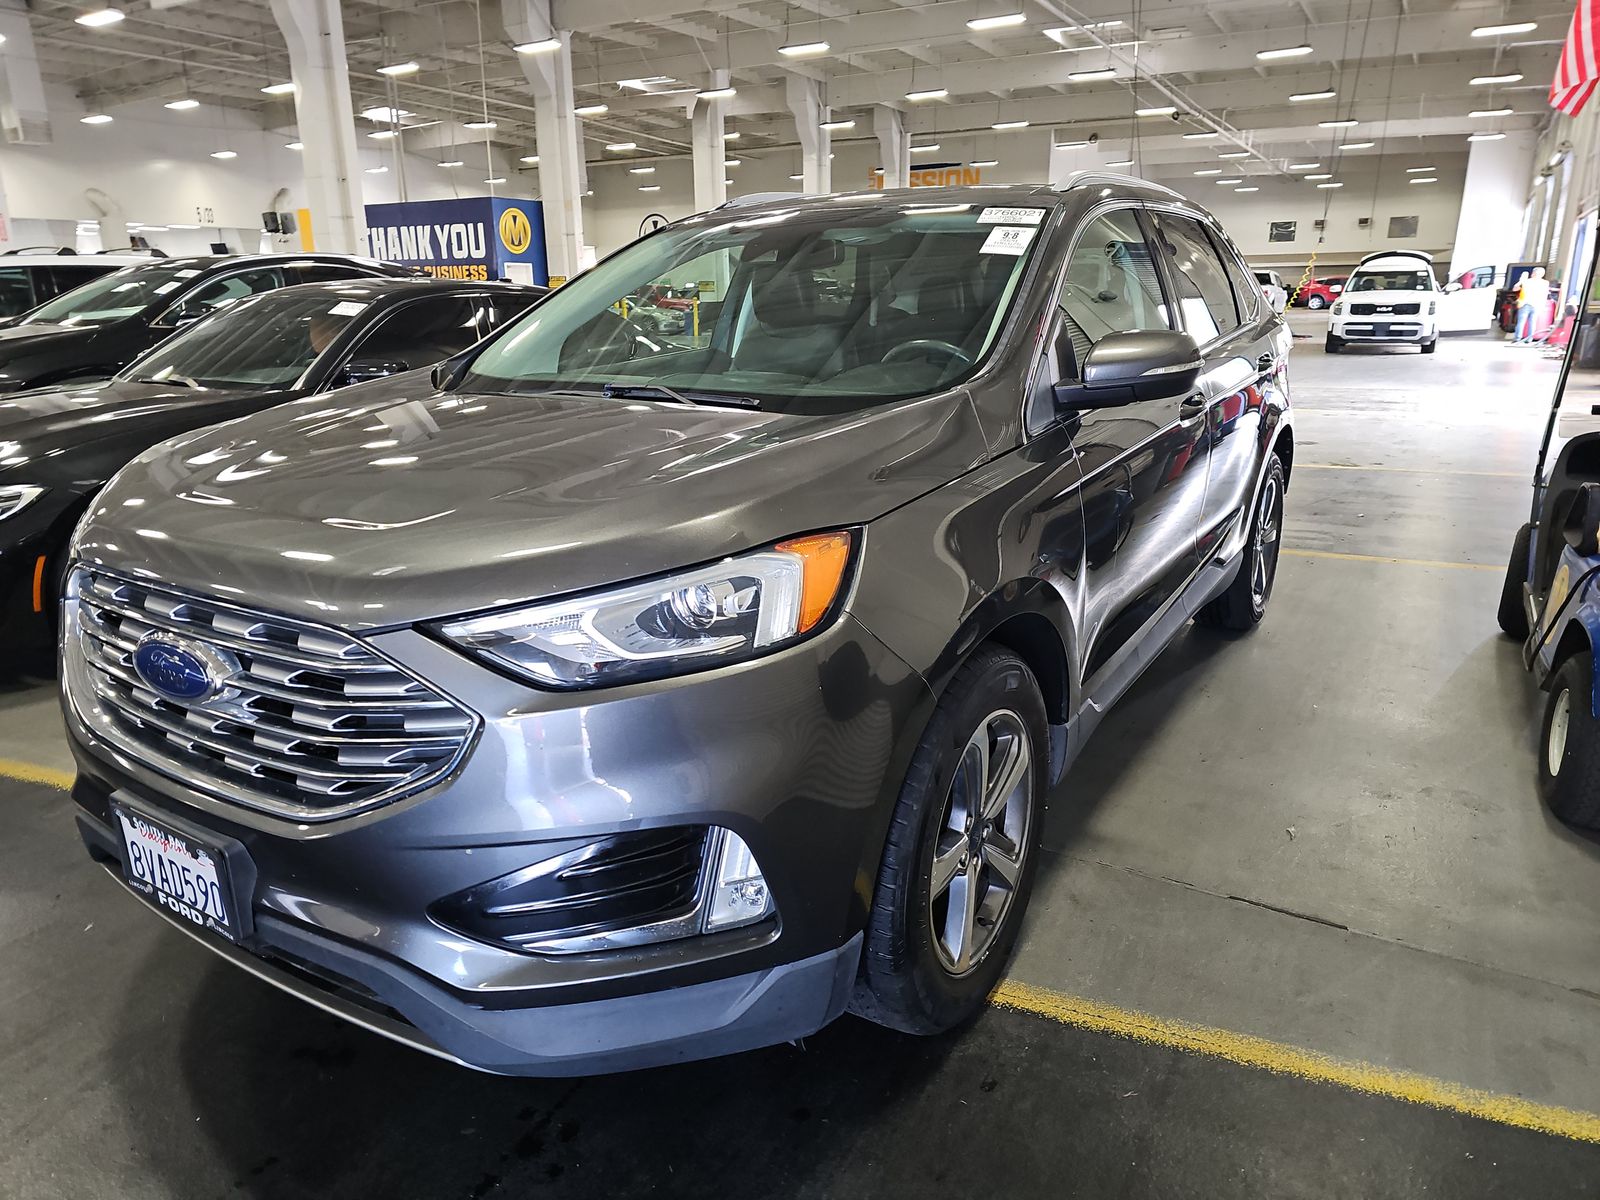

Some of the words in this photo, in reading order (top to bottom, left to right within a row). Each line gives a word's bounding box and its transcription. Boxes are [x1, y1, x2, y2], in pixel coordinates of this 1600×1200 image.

[877, 168, 981, 188] SSION
[984, 208, 1043, 217] 3766021
[434, 222, 486, 260] YOU
[132, 816, 165, 839] SOUTH
[130, 840, 226, 922] 8VAD590
[157, 891, 204, 926] FORD
